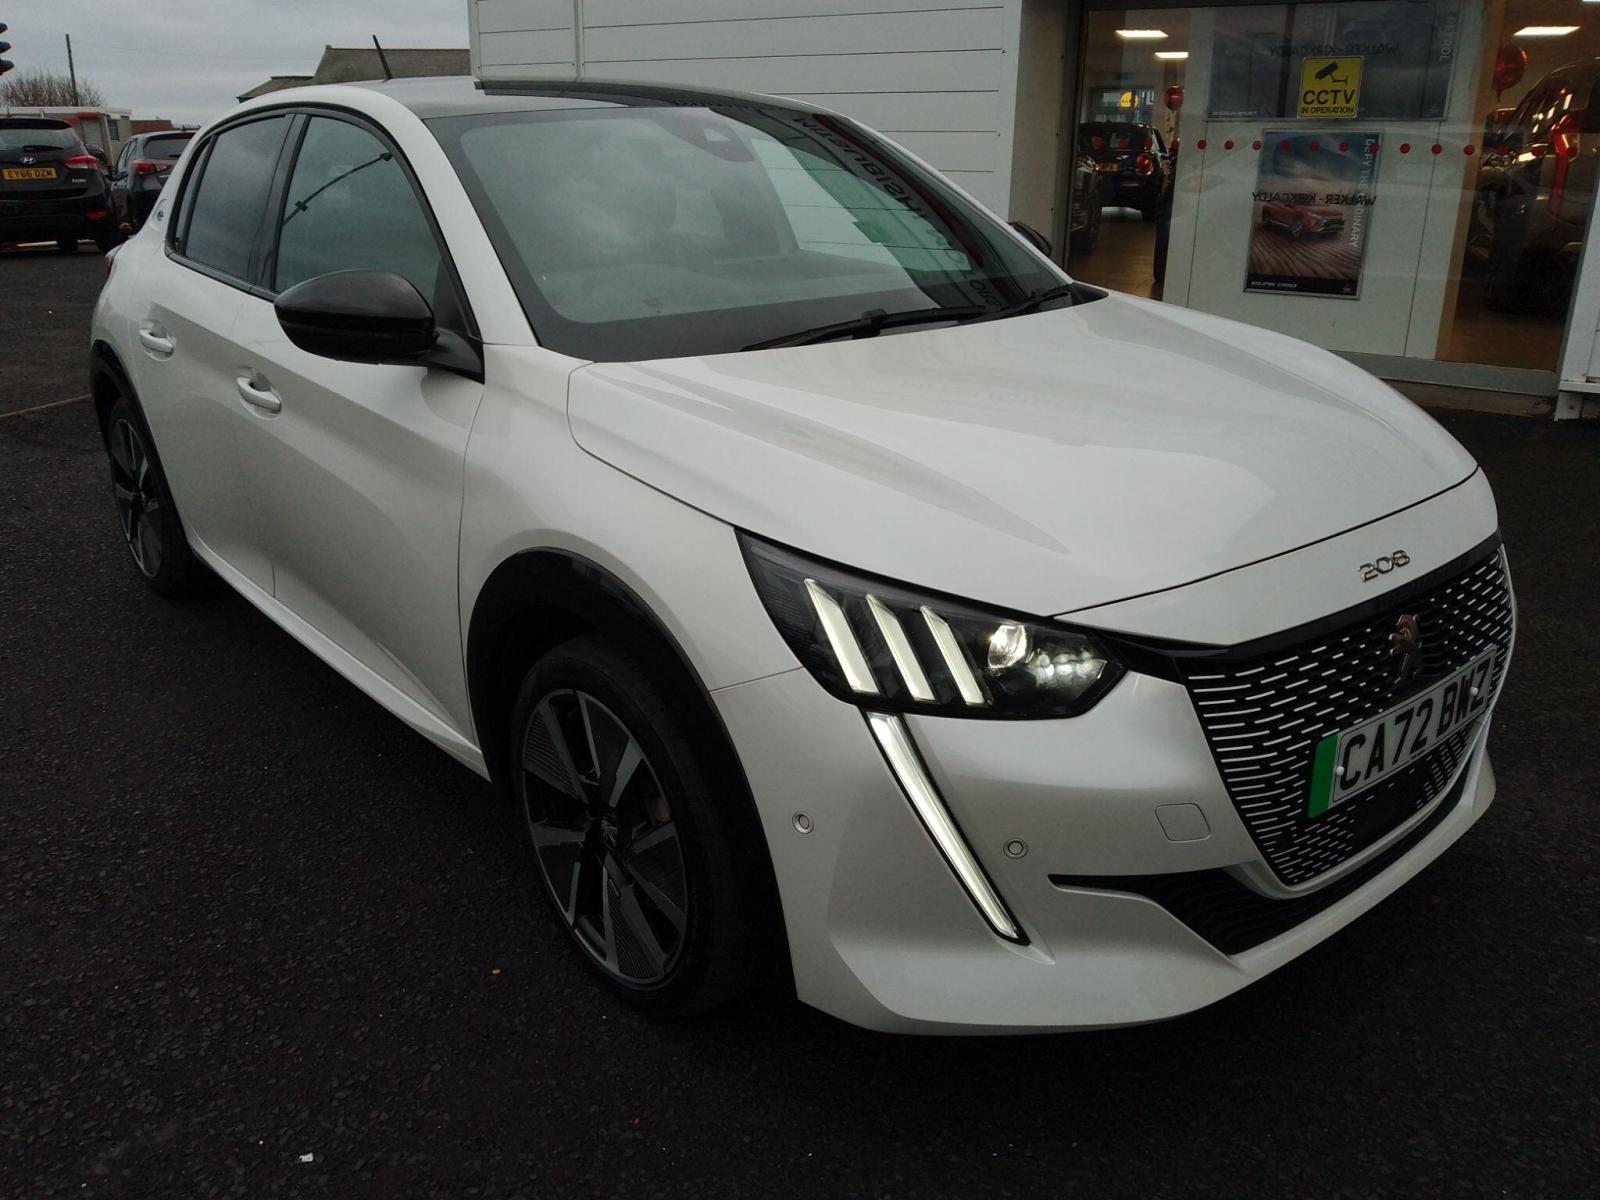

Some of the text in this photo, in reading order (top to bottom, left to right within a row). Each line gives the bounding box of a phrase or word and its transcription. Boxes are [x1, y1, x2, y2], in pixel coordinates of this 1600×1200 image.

[1303, 89, 1355, 105] CCTV
[1359, 169, 1370, 190] THE
[1358, 549, 1411, 583] 208
[1340, 698, 1434, 791] CA72
